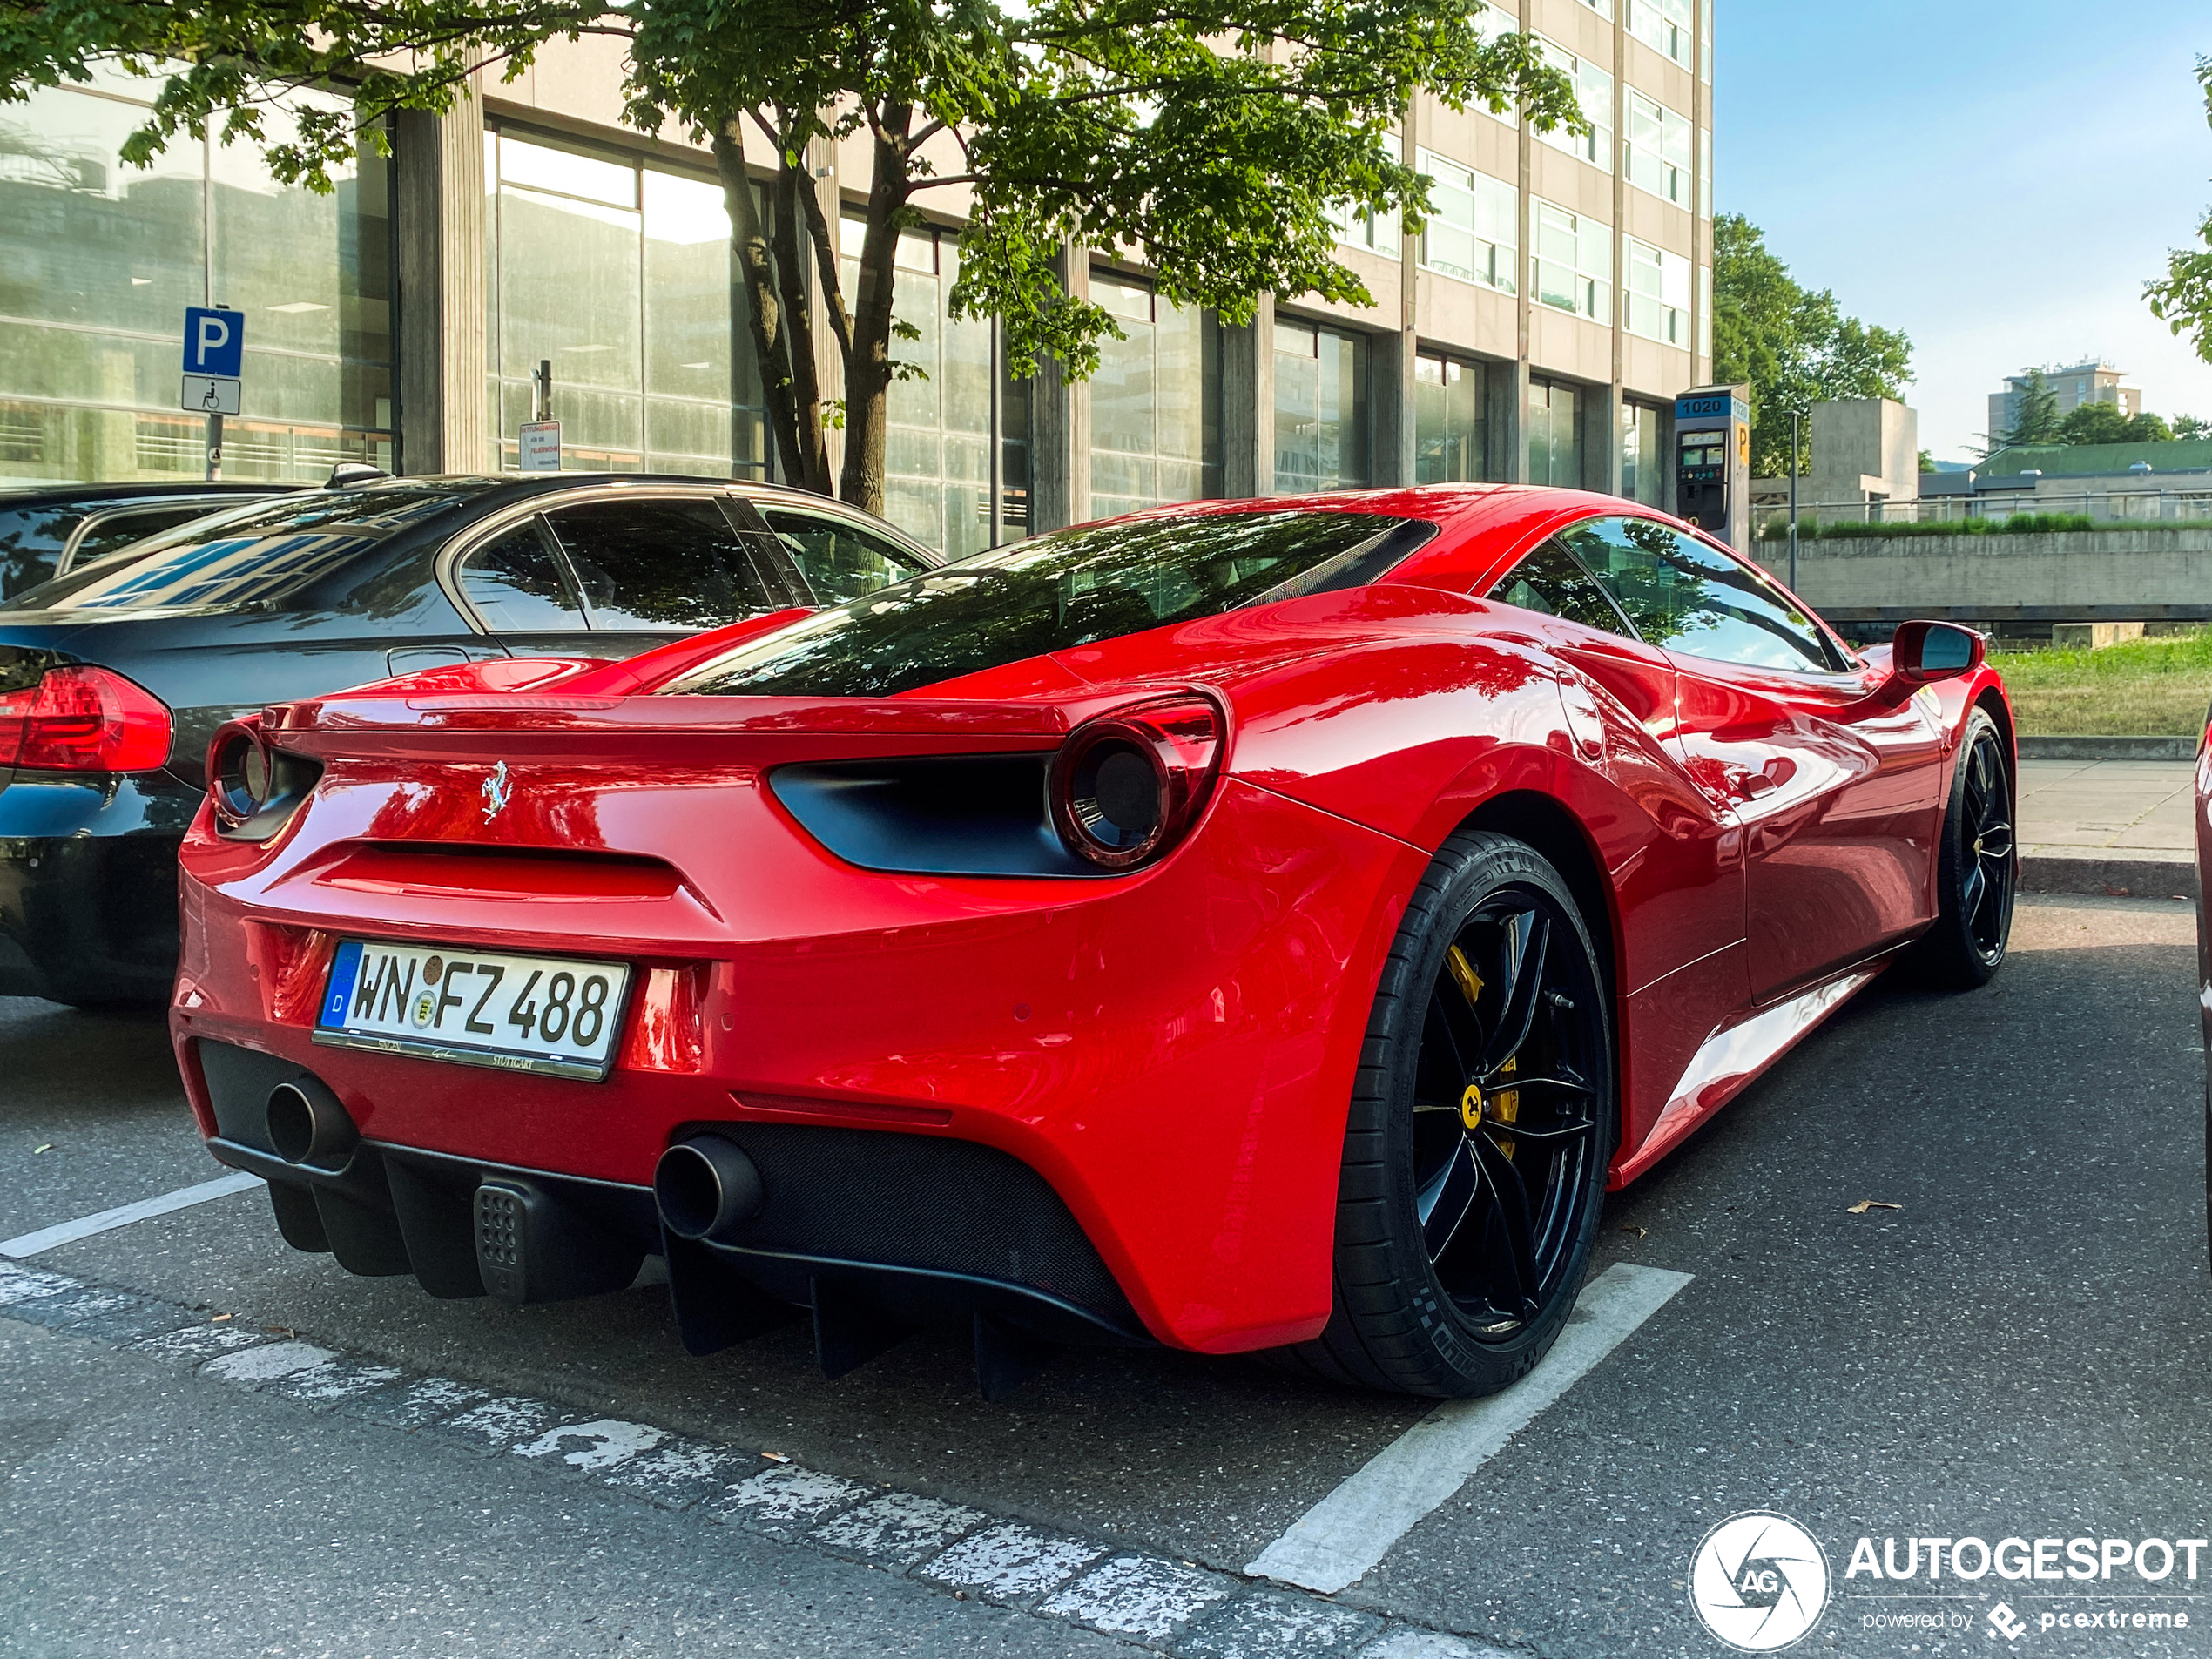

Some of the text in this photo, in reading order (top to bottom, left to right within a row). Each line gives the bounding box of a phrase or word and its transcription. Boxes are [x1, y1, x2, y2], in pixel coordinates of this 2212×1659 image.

[197, 316, 229, 366] P
[1683, 400, 1722, 414] 1020
[1733, 401, 1747, 418] 1020
[1739, 428, 1747, 456] P
[332, 995, 342, 1013] D
[353, 954, 416, 1024] WN
[434, 961, 505, 1035] FZ
[508, 970, 609, 1047] 488
[492, 1055, 535, 1069] STUTTGART
